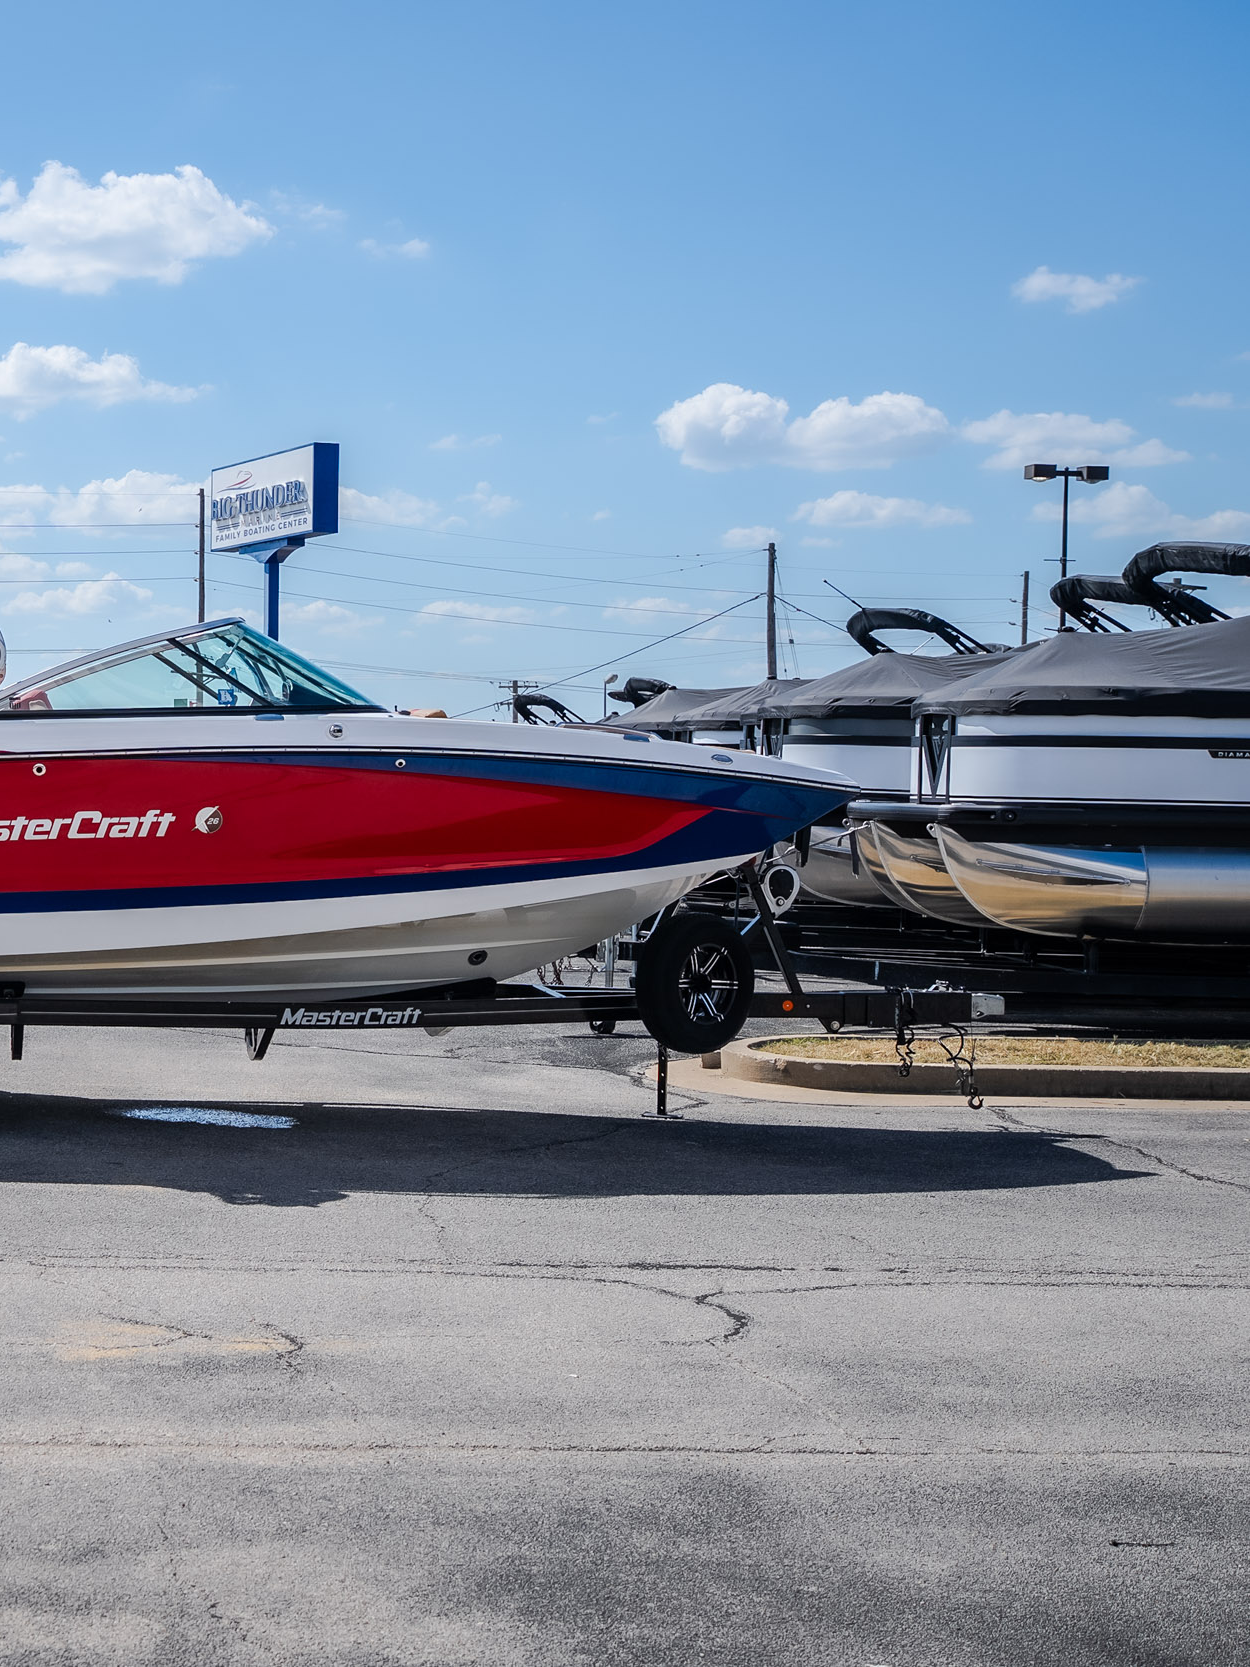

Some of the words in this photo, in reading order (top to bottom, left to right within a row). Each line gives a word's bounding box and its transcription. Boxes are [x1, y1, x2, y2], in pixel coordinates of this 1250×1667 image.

[212, 496, 236, 520] BIG
[236, 480, 304, 515] THUNDER
[215, 530, 241, 542] FAMILY
[244, 523, 276, 537] BOATING
[278, 517, 308, 530] CENTER
[207, 817, 219, 825] 26
[280, 1007, 421, 1025] MasterCraft
